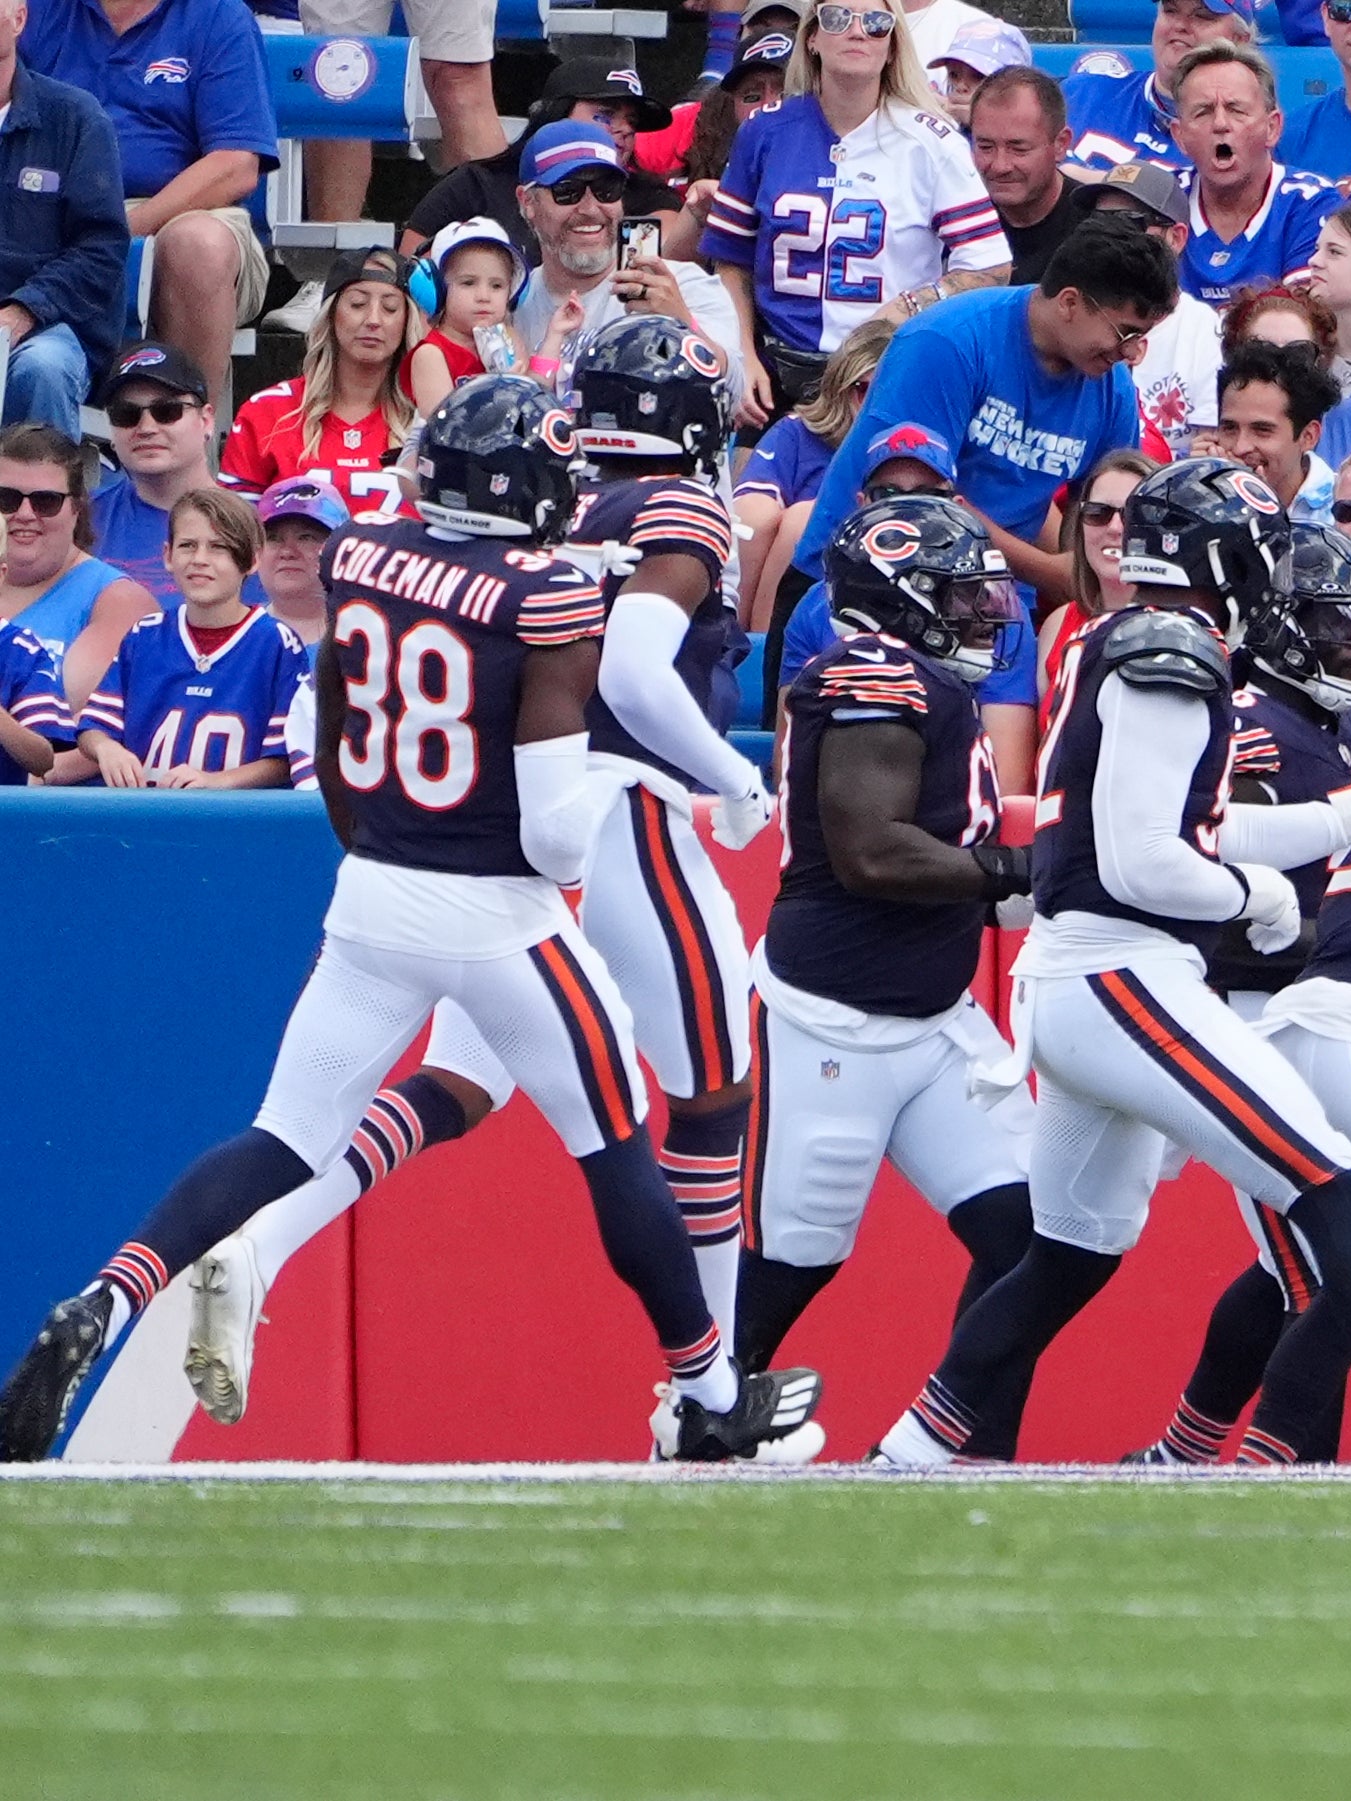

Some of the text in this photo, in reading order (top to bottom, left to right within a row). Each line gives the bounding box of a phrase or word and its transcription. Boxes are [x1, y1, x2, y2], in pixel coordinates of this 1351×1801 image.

[772, 192, 888, 303] 22
[1200, 287, 1231, 300] BILLS
[331, 536, 508, 625] COLEMAN III
[1133, 564, 1168, 576] CHANGE
[334, 599, 480, 812] 38
[143, 709, 245, 786] 40
